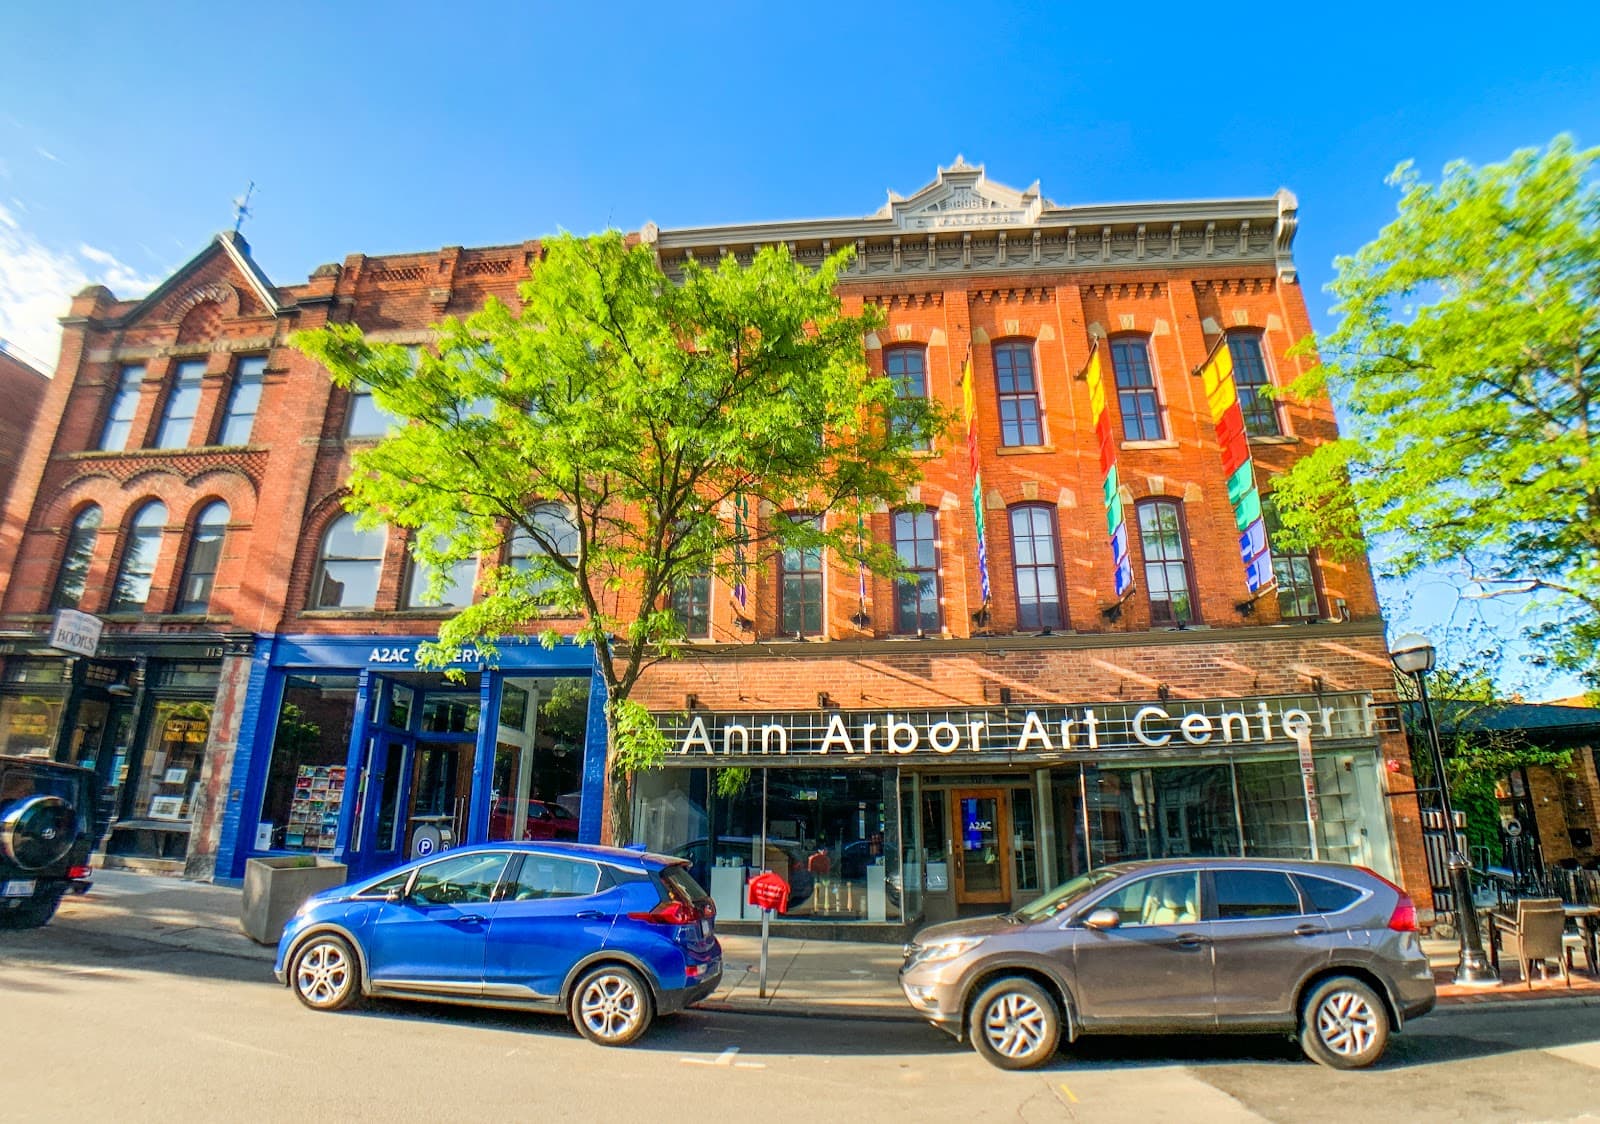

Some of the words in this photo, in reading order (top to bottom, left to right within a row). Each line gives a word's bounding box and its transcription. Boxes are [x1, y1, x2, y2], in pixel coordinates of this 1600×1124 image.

[58, 629, 96, 650] BOOKS
[369, 648, 410, 662] A2AC
[680, 717, 787, 755] Ann
[821, 713, 985, 754] Arbor
[1016, 711, 1099, 751] Art
[1133, 704, 1334, 745] Center
[968, 821, 992, 831] A2AC
